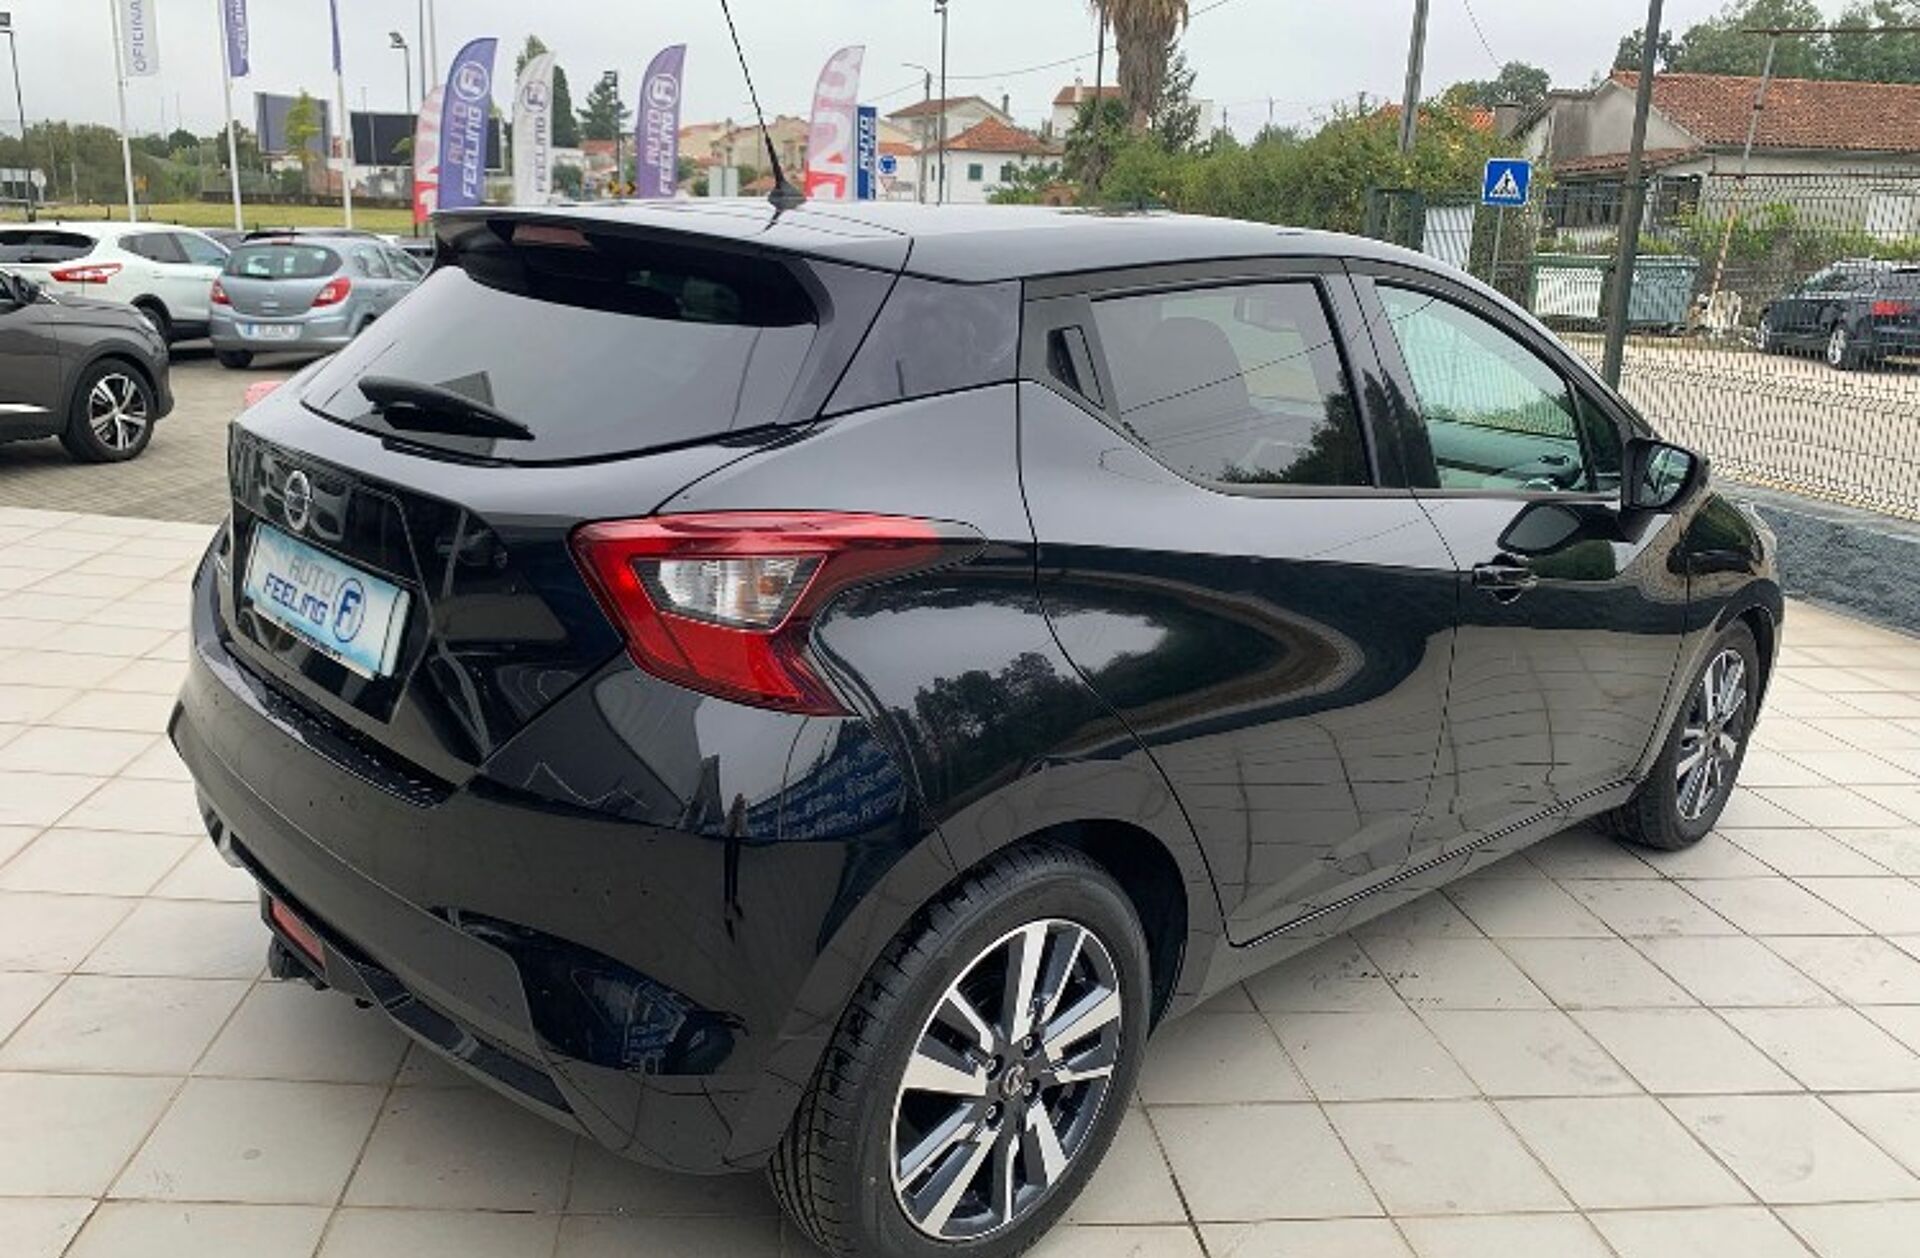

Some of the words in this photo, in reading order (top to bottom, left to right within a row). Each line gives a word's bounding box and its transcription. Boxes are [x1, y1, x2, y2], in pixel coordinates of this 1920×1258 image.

[448, 101, 467, 165] AUTO
[462, 106, 482, 199] FEELING
[647, 108, 660, 164] AUTO
[660, 111, 675, 195] FEELING
[859, 114, 869, 170] AUTO
[263, 572, 328, 626] FEELING
[289, 555, 336, 598] AUTO
